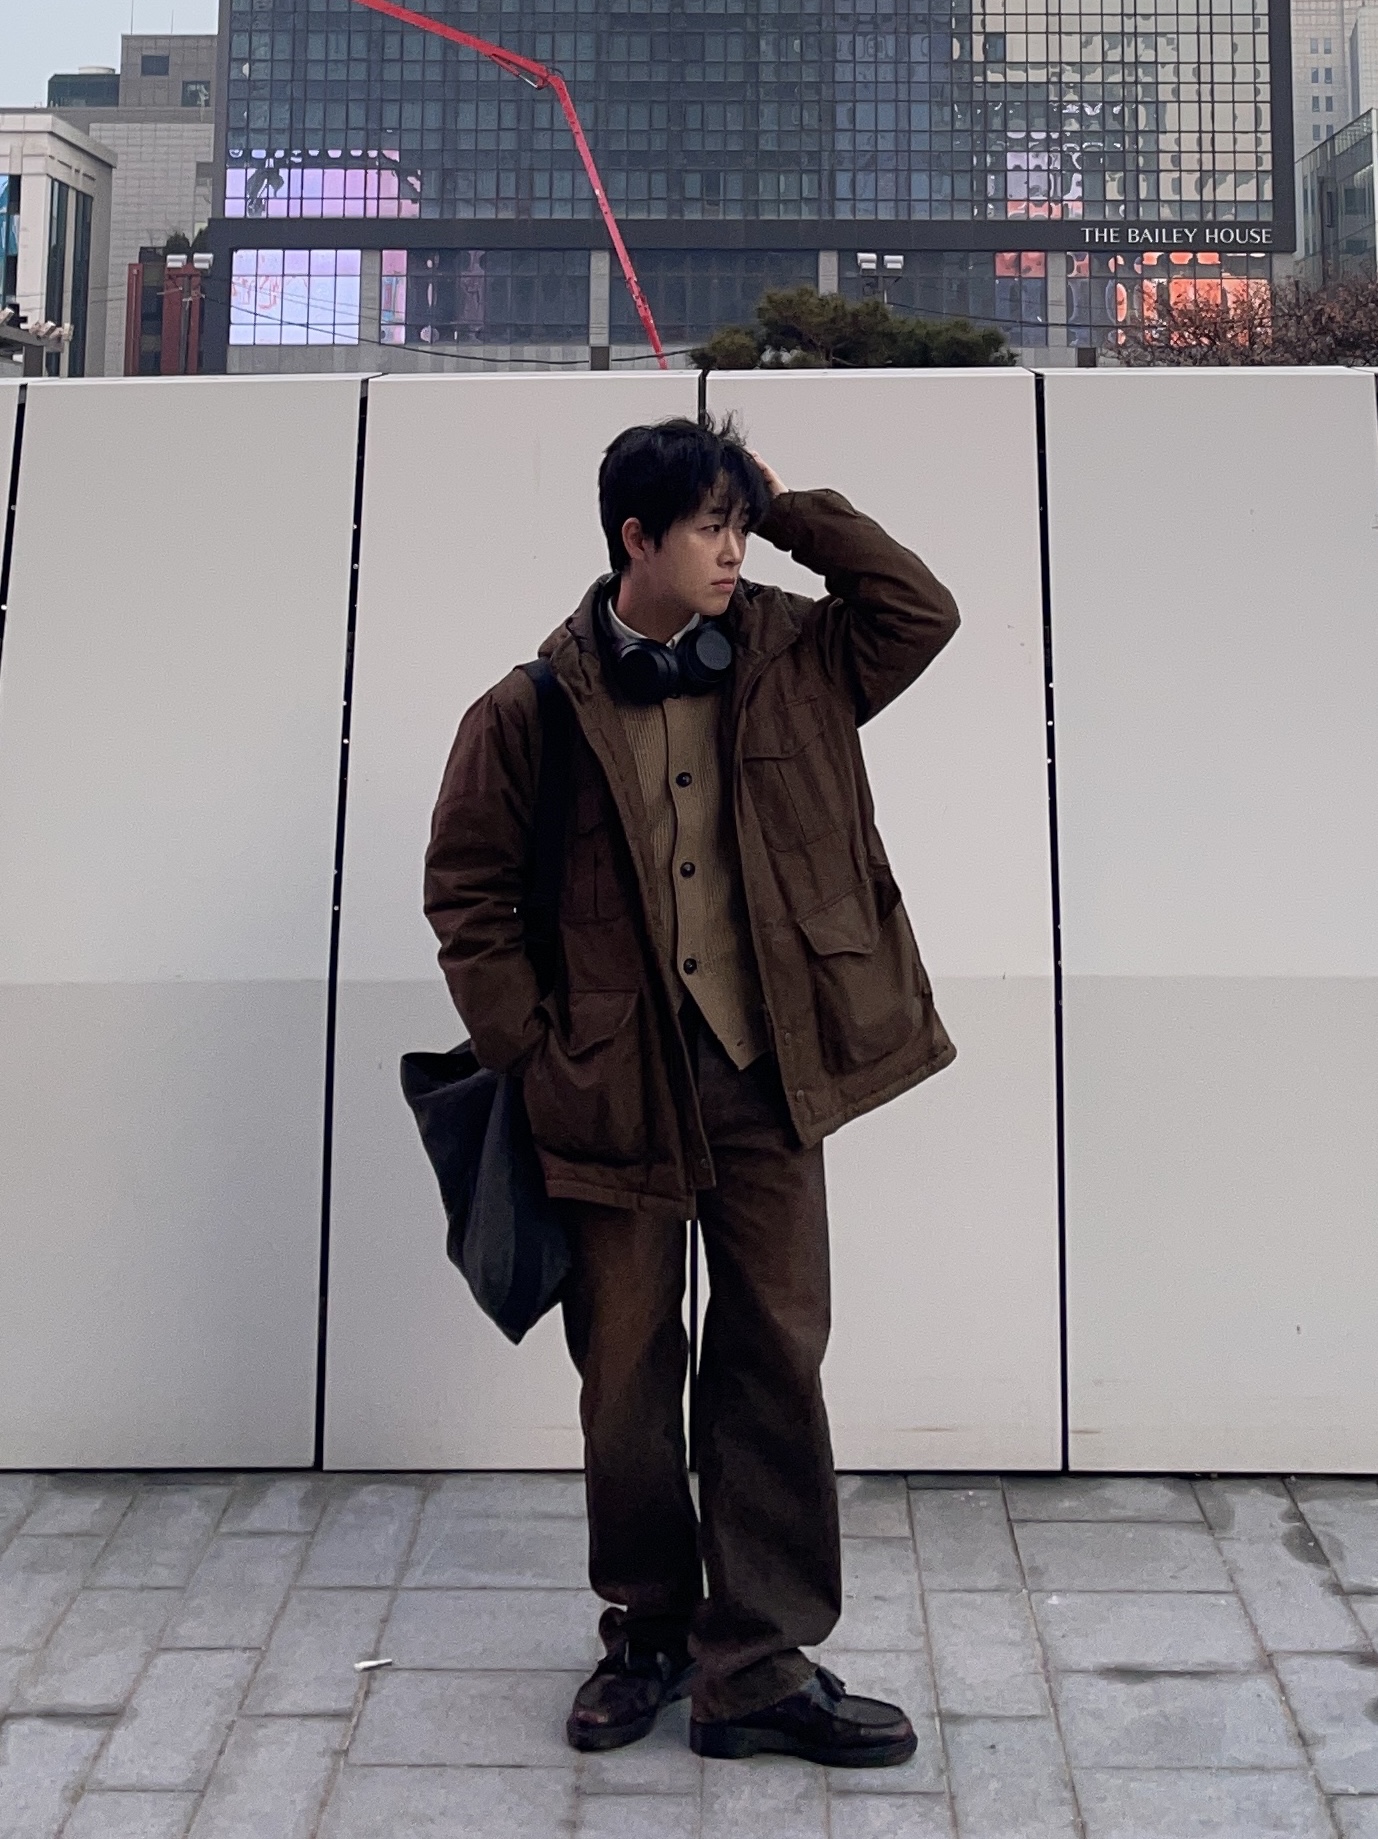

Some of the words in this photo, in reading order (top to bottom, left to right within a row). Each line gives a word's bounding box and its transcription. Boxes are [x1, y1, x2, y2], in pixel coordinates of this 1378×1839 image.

[1080, 227, 1121, 244] THE
[1127, 227, 1198, 244] BAILEY
[1204, 227, 1273, 244] HOUSE
